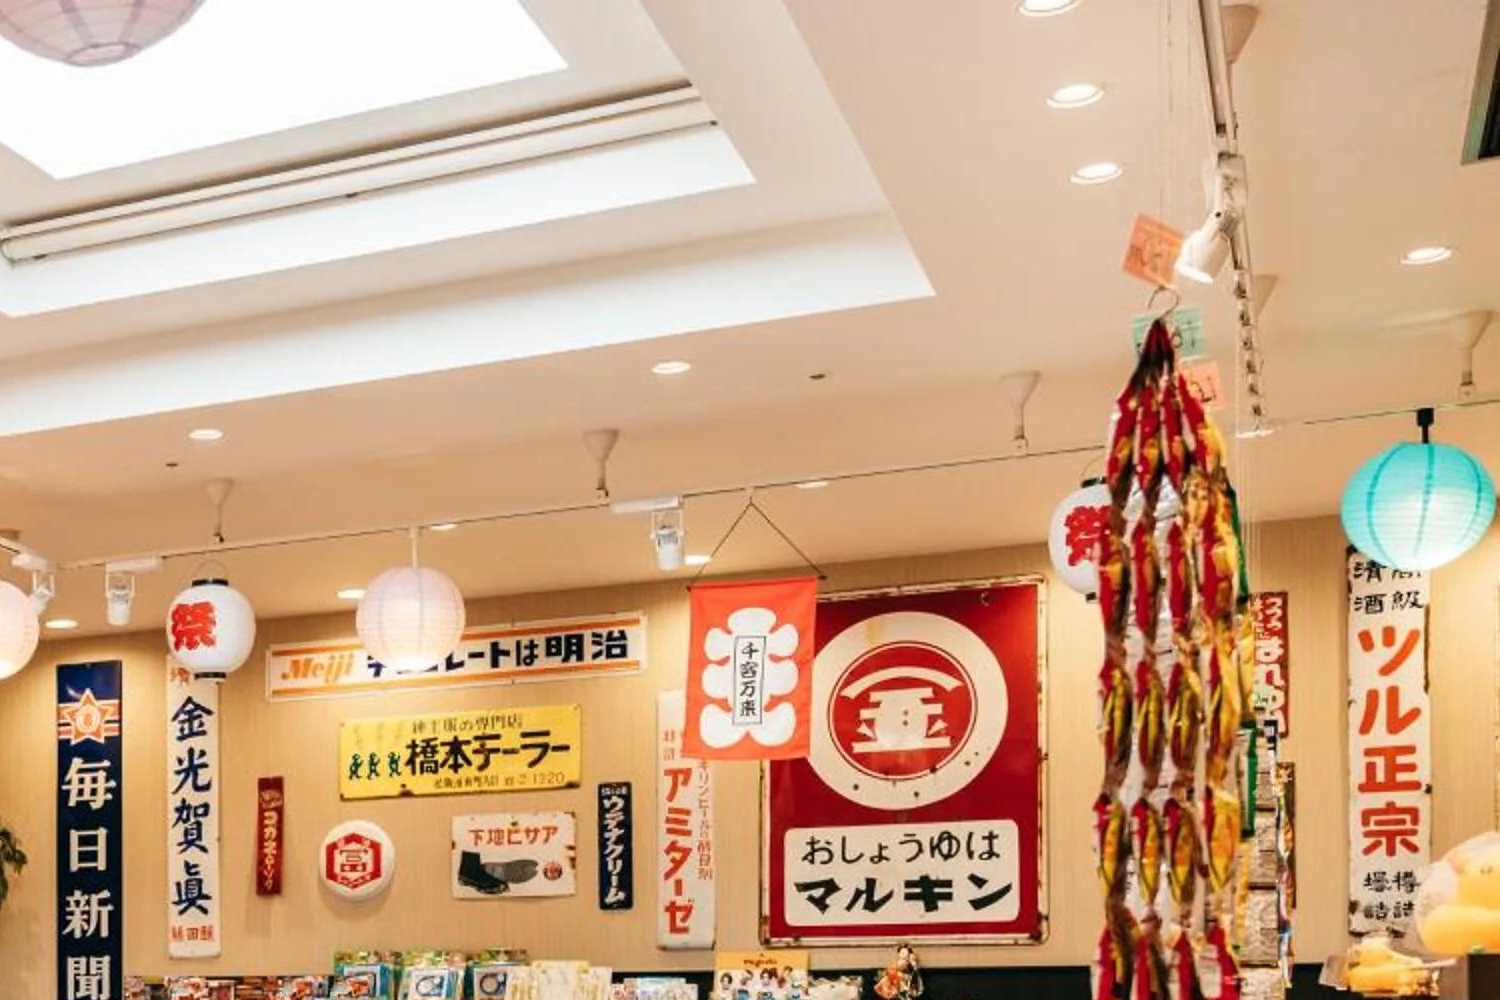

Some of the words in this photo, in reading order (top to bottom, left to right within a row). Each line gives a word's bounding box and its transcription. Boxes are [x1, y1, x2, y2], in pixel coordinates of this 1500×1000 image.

[170, 601, 217, 652] 祭
[280, 652, 355, 684] Meiji
[404, 730, 571, 776] 橋本テーラー
[1357, 625, 1424, 858] ツル正宗
[663, 766, 695, 935] アミターゼ
[800, 829, 1001, 867] おしょうゆは
[793, 872, 1013, 913] マルキン
